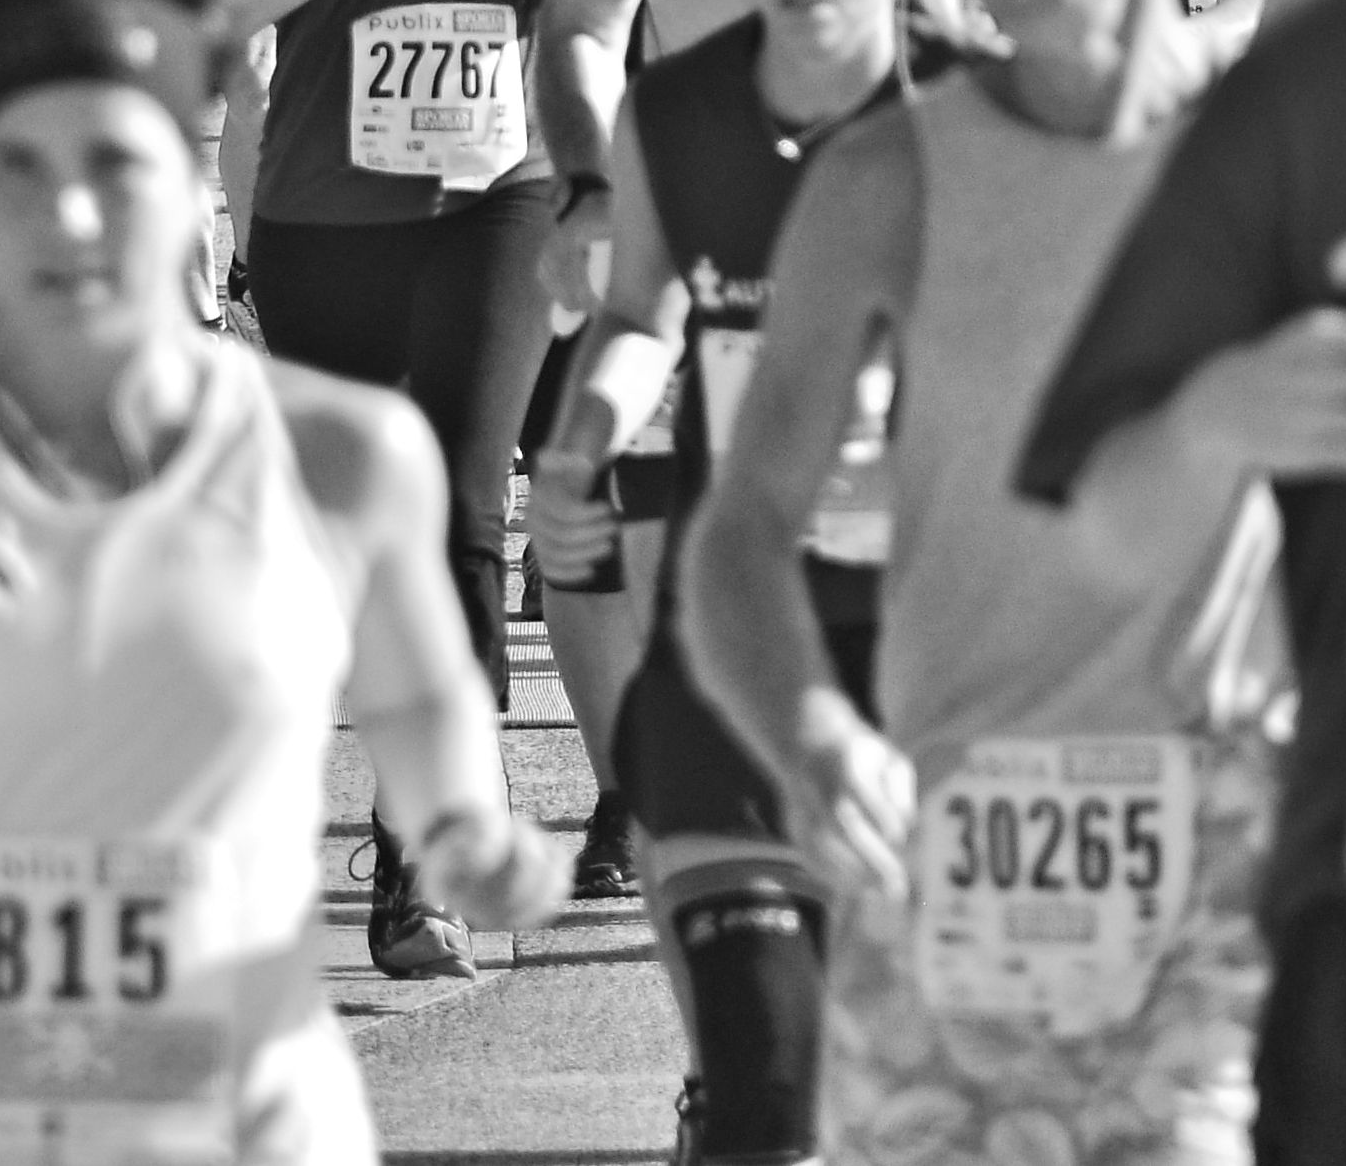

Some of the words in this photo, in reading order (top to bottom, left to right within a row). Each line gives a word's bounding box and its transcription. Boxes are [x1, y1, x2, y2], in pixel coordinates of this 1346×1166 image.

[369, 12, 444, 32] Publix
[368, 41, 505, 100] 27767
[945, 792, 1163, 891] 30265
